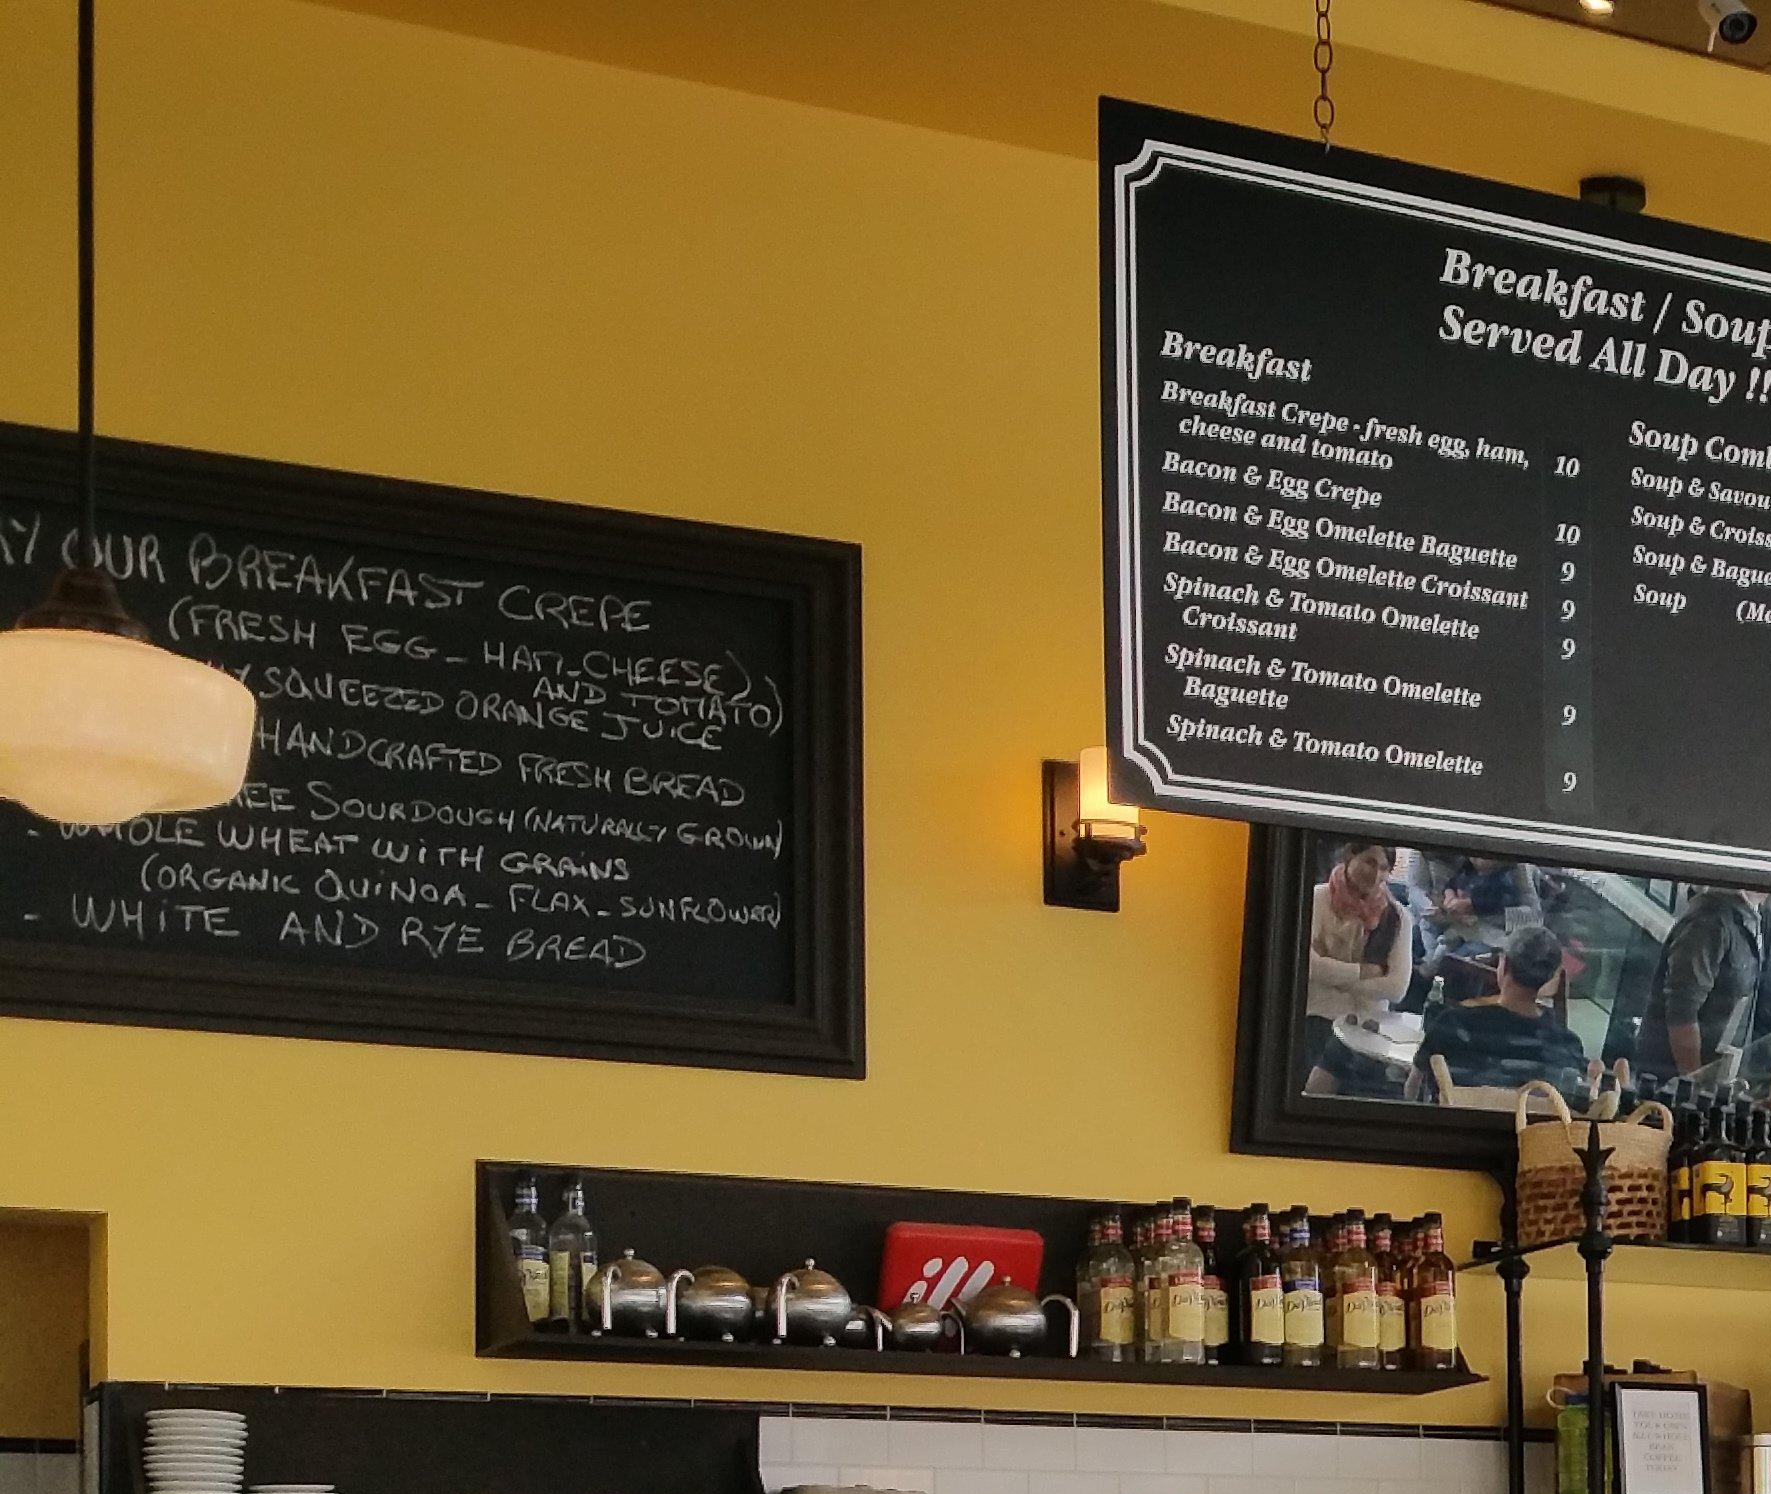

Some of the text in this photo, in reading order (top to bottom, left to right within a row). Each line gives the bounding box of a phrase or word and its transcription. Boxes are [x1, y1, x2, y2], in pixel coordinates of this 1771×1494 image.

[1439, 247, 1646, 322] Breakfast
[1160, 330, 1313, 383] Breakfast
[1439, 304, 1583, 366] Served
[1588, 336, 1647, 378] All
[1653, 348, 1736, 404] Day
[1161, 380, 1277, 418] Breakfast
[1281, 402, 1349, 434] Crepe
[1359, 417, 1423, 446] fresh
[1427, 433, 1471, 460] egg,
[1475, 437, 1529, 470] ham,
[1554, 455, 1580, 478] 10
[1178, 414, 1393, 470] cheese and tomato
[1629, 420, 1699, 462] Soup
[1161, 450, 1581, 546] Bacon & Egg Crepe 10
[1630, 466, 1683, 498] Soup
[1687, 477, 1705, 498] &
[1162, 491, 1575, 582] Bacon & Egg Omelette Baguette 9
[62, 527, 165, 584] OUR
[189, 532, 484, 609] BREAKFAST
[500, 585, 652, 632] CREPE
[1163, 531, 1576, 620] Bacon & Egg Omelette Croissant 9
[1633, 583, 1687, 614] Soup
[169, 595, 316, 650] (FRESH
[341, 624, 437, 661] EGG
[1163, 571, 1576, 660] Spinach & Tomato Omelette 9
[259, 666, 444, 715] SQUEEZED
[456, 690, 588, 732] ORANGE
[533, 677, 607, 704] AND
[259, 718, 745, 806] HANDCRAFTED FRESH BREAD
[218, 820, 359, 856] WHEAT
[307, 780, 515, 834] SOURDOUGH
[509, 883, 590, 917] FLAX
[279, 910, 380, 949] AND
[401, 917, 484, 959] RYE
[507, 928, 646, 968] BREAD
